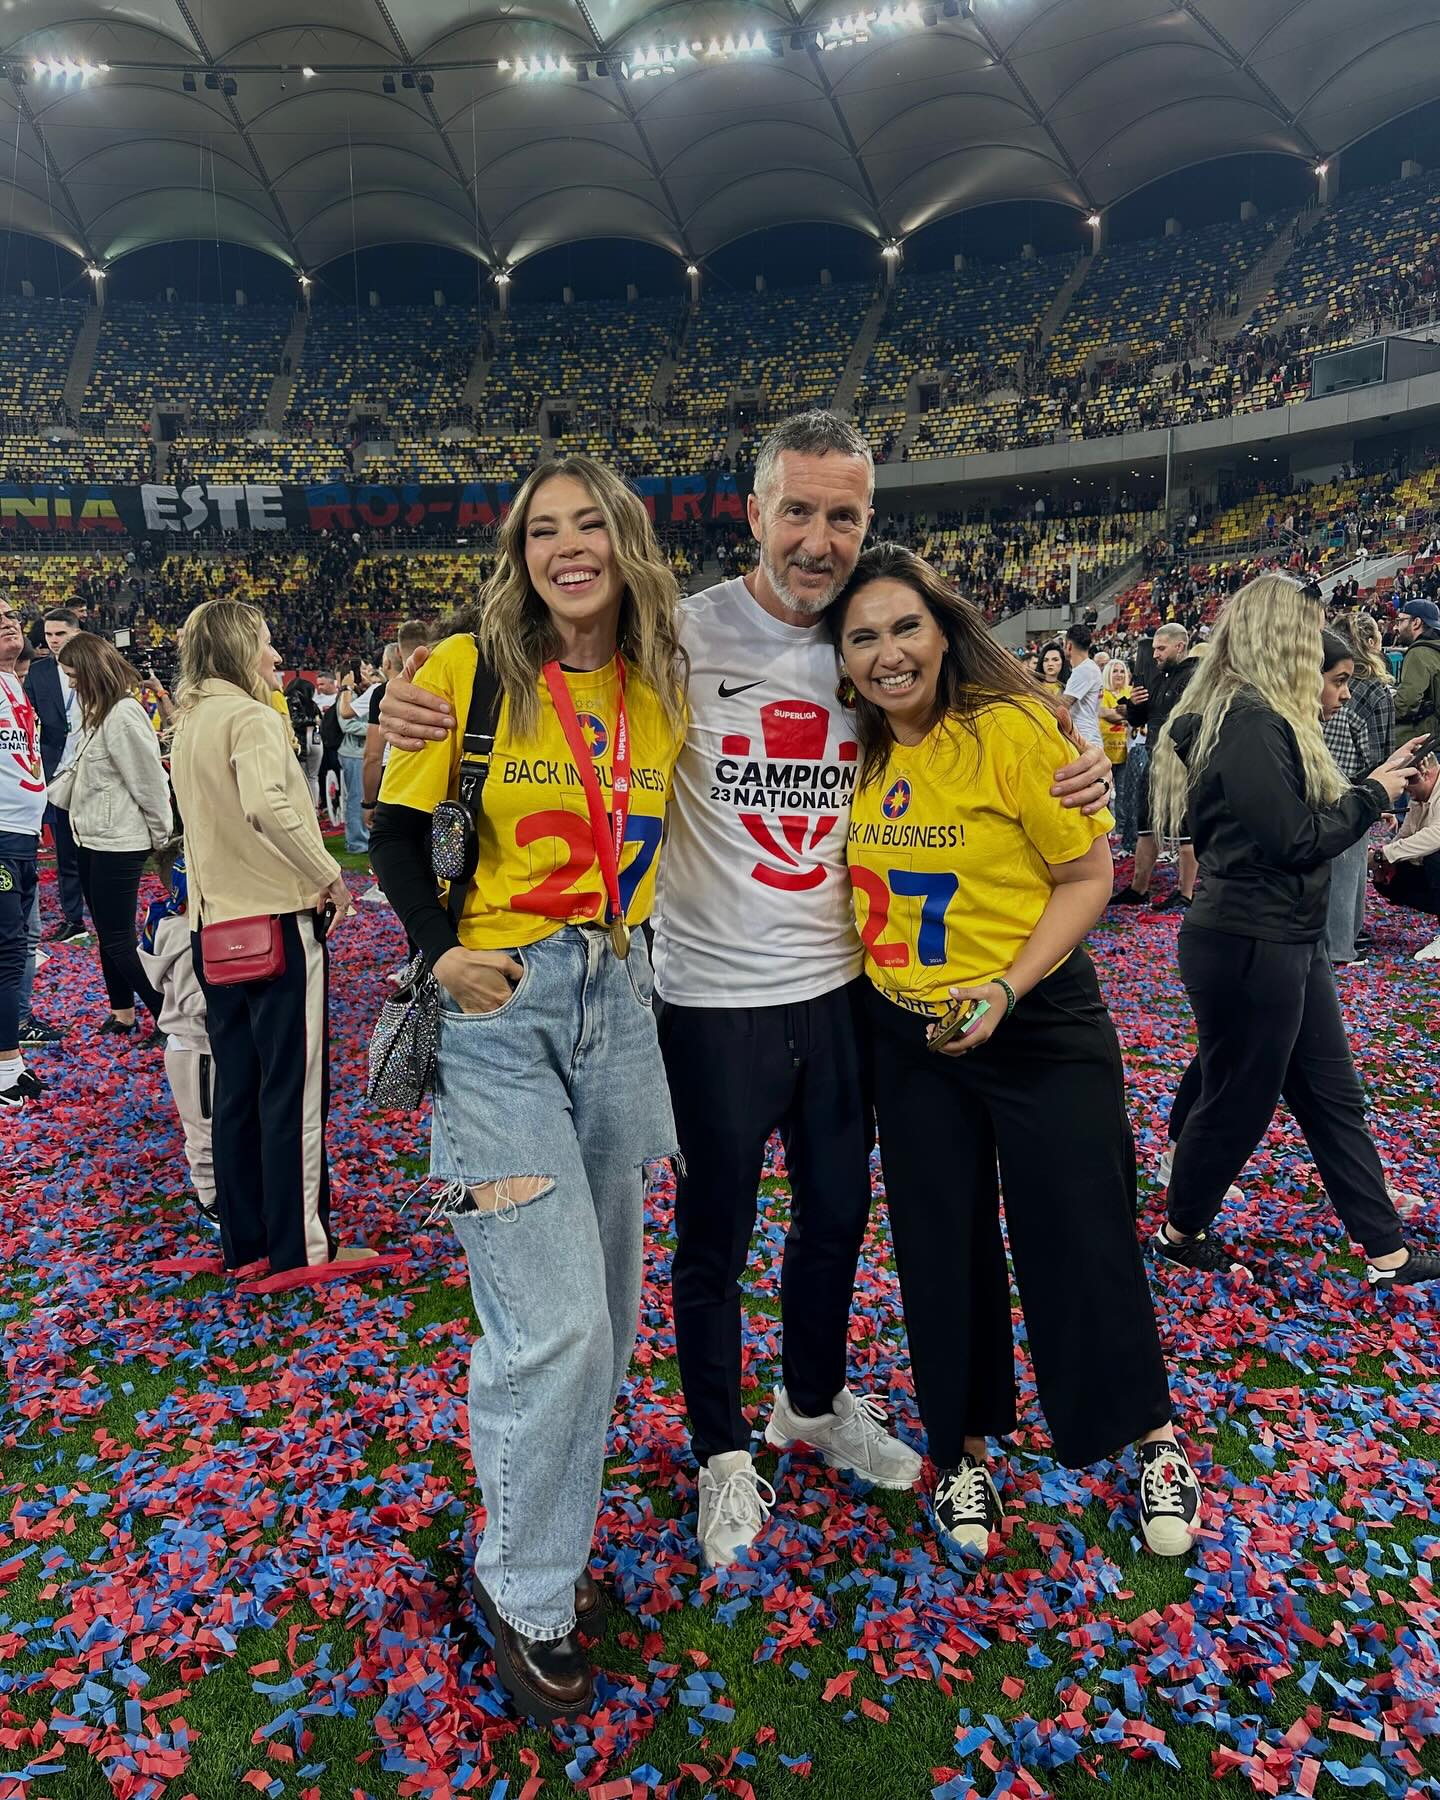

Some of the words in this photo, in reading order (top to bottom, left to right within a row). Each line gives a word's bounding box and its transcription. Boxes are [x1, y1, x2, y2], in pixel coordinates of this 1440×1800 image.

[140, 483, 287, 531] ESTE
[774, 709, 818, 720] SUPERLIGA
[503, 759, 561, 785] BACK
[716, 759, 857, 789] CAMPION
[710, 786, 731, 801] 23
[863, 823, 880, 845] IN
[510, 809, 663, 925] 27
[848, 864, 959, 968] 27
